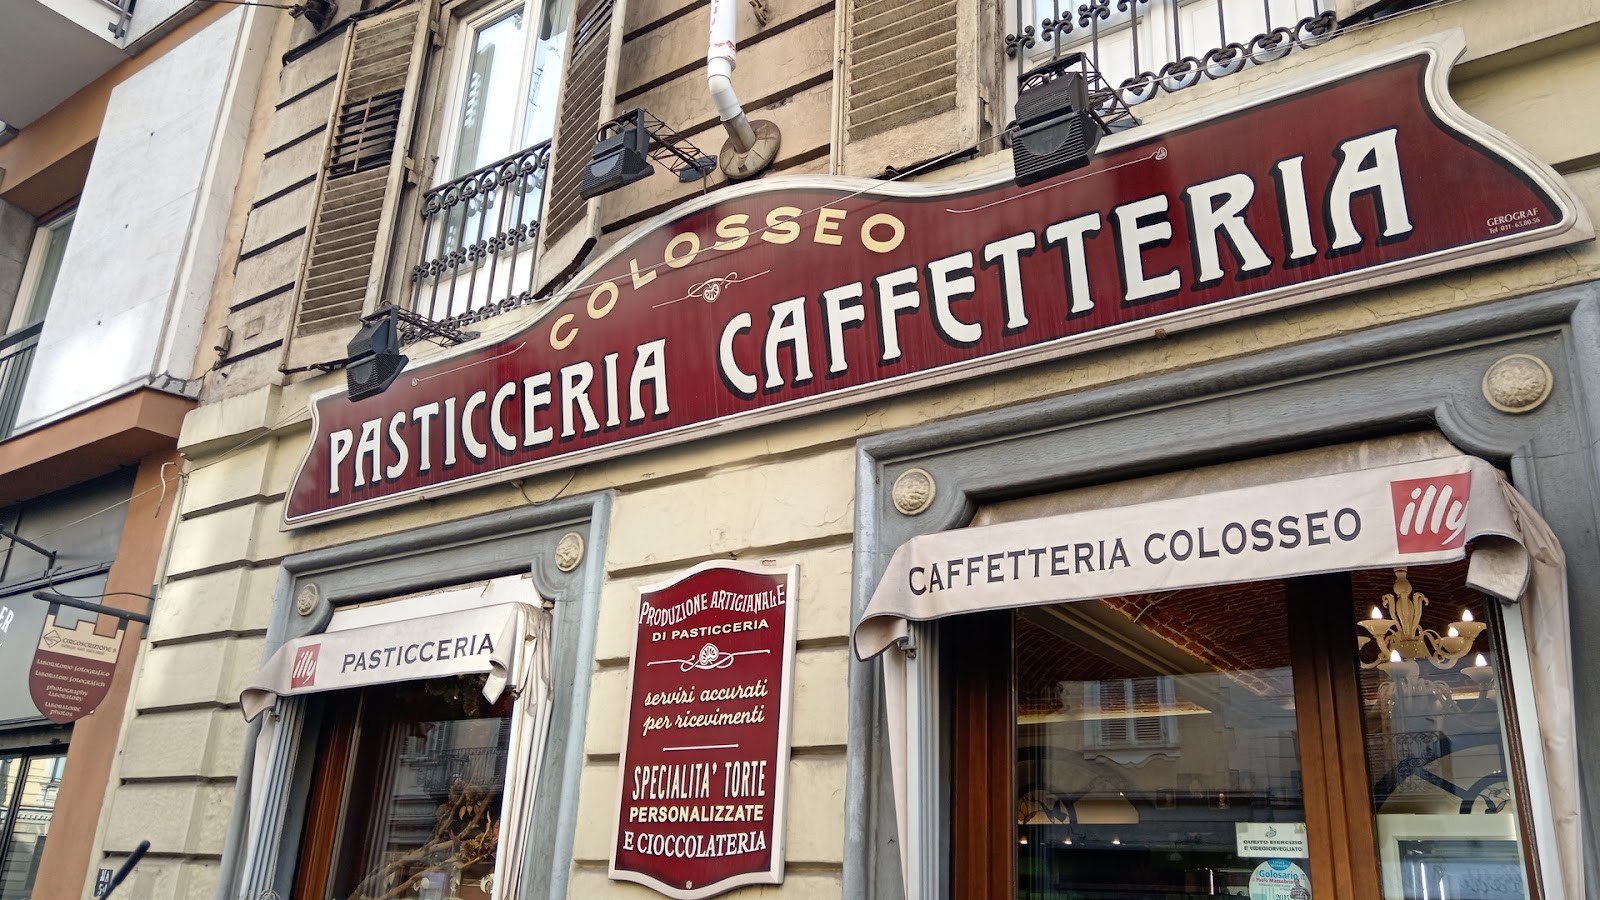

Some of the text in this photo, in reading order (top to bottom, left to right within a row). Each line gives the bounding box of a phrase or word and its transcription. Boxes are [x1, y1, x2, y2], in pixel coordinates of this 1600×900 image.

[1487, 207, 1539, 227] GEROGRAF
[550, 207, 906, 351] COLOSSEO
[329, 127, 1414, 495] PASTICCERIA CAFFETTERIA
[908, 484, 1469, 596] CAFFETTERIA COLOSSEO illy
[639, 584, 786, 626] PRODUZIONE ARTIGIANALE
[652, 618, 769, 642] DI PASTICCERIA
[292, 633, 494, 680] illy PASTICCERIA
[644, 679, 768, 707] servizi accurati
[642, 704, 765, 736] per ricevimenti
[724, 760, 767, 798] TORTE
[629, 804, 764, 823] PERSONALIZZATE
[623, 831, 767, 859] E CIOCCOLATERIA
